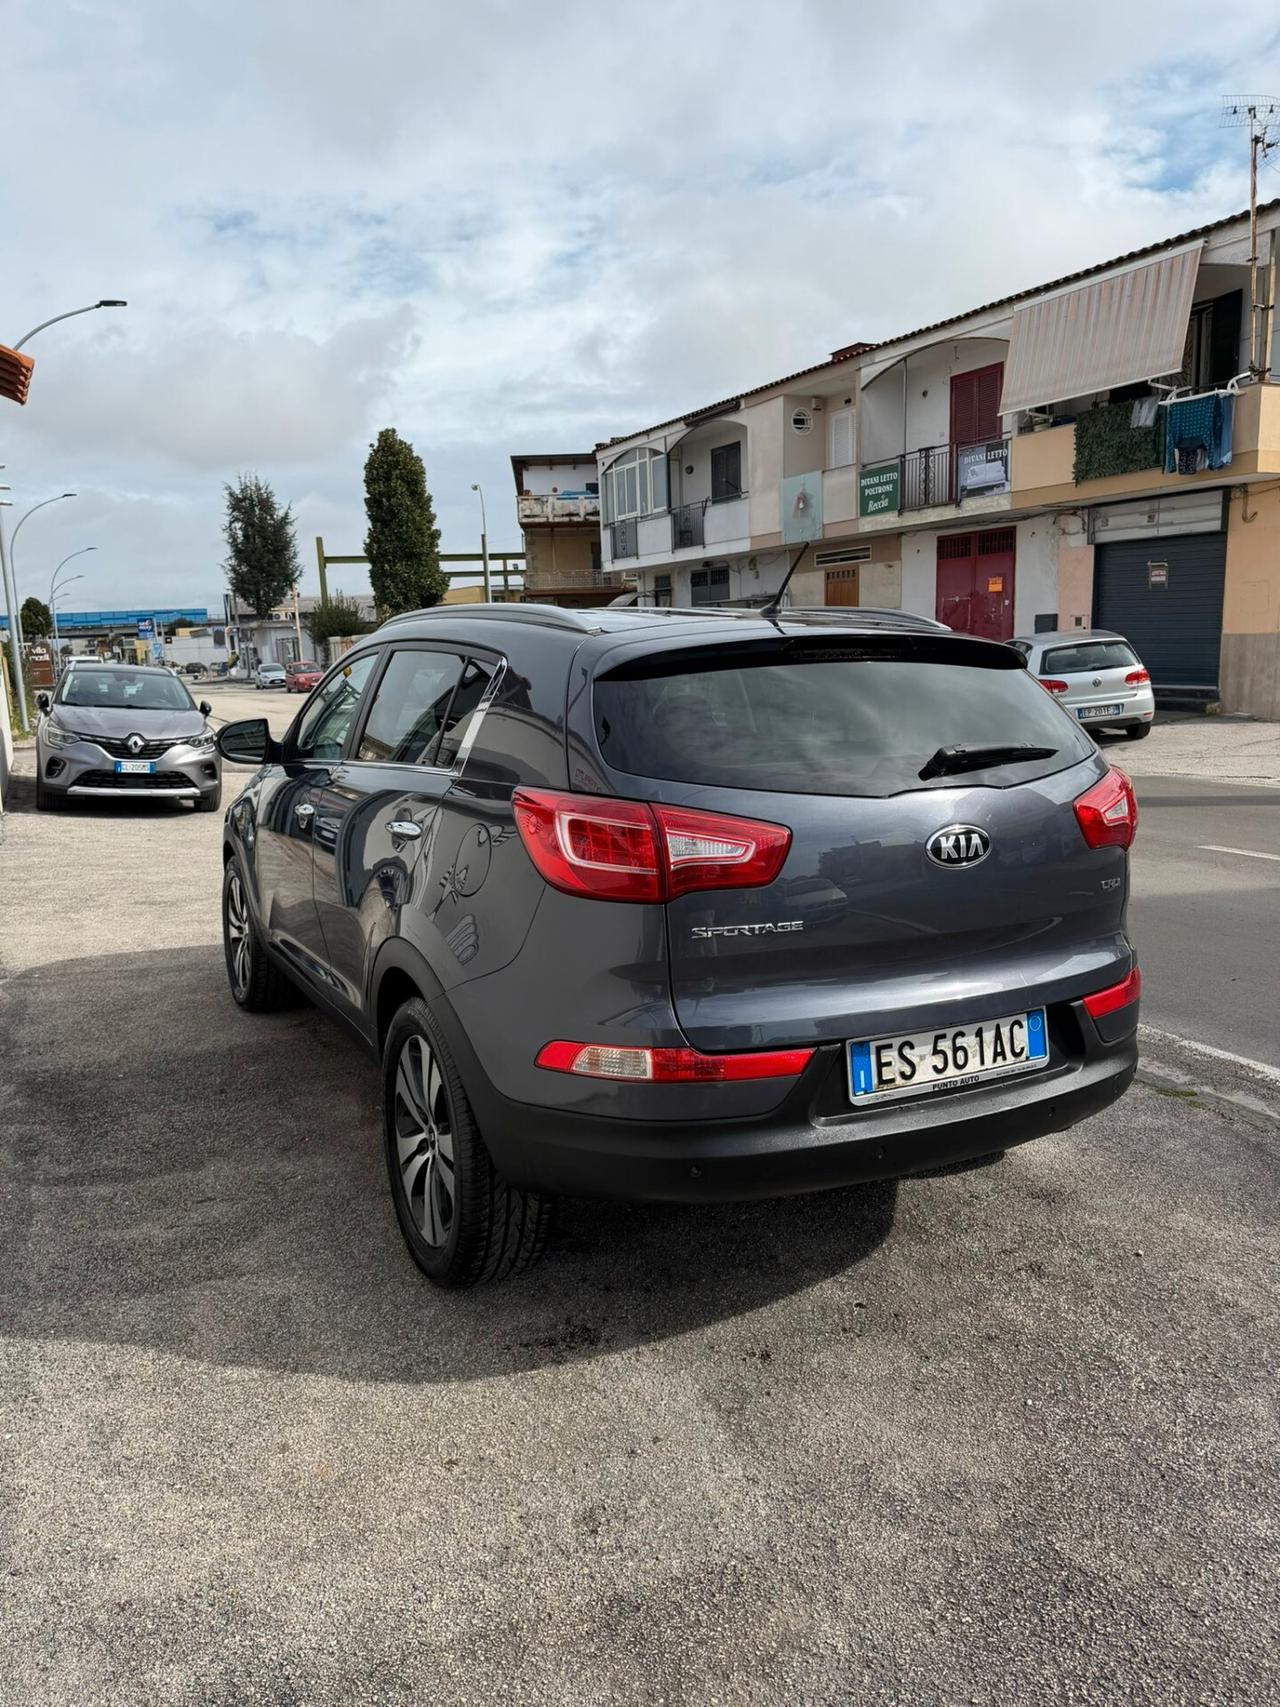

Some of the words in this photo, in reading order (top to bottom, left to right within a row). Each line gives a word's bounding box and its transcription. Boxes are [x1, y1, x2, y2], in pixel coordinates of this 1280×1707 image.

[964, 453, 986, 464] DIVANI
[987, 449, 1008, 460] LETTO
[861, 476, 879, 487] DIVANI
[880, 472, 898, 483] LETTO
[865, 484, 893, 496] POLTRONE
[939, 834, 984, 859] KIA
[691, 920, 804, 939] SPORTAGE
[875, 1040, 917, 1086] ES
[931, 1019, 1026, 1075] 561AC
[932, 1079, 959, 1091] PUNTO
[959, 1075, 980, 1086] AUTO
